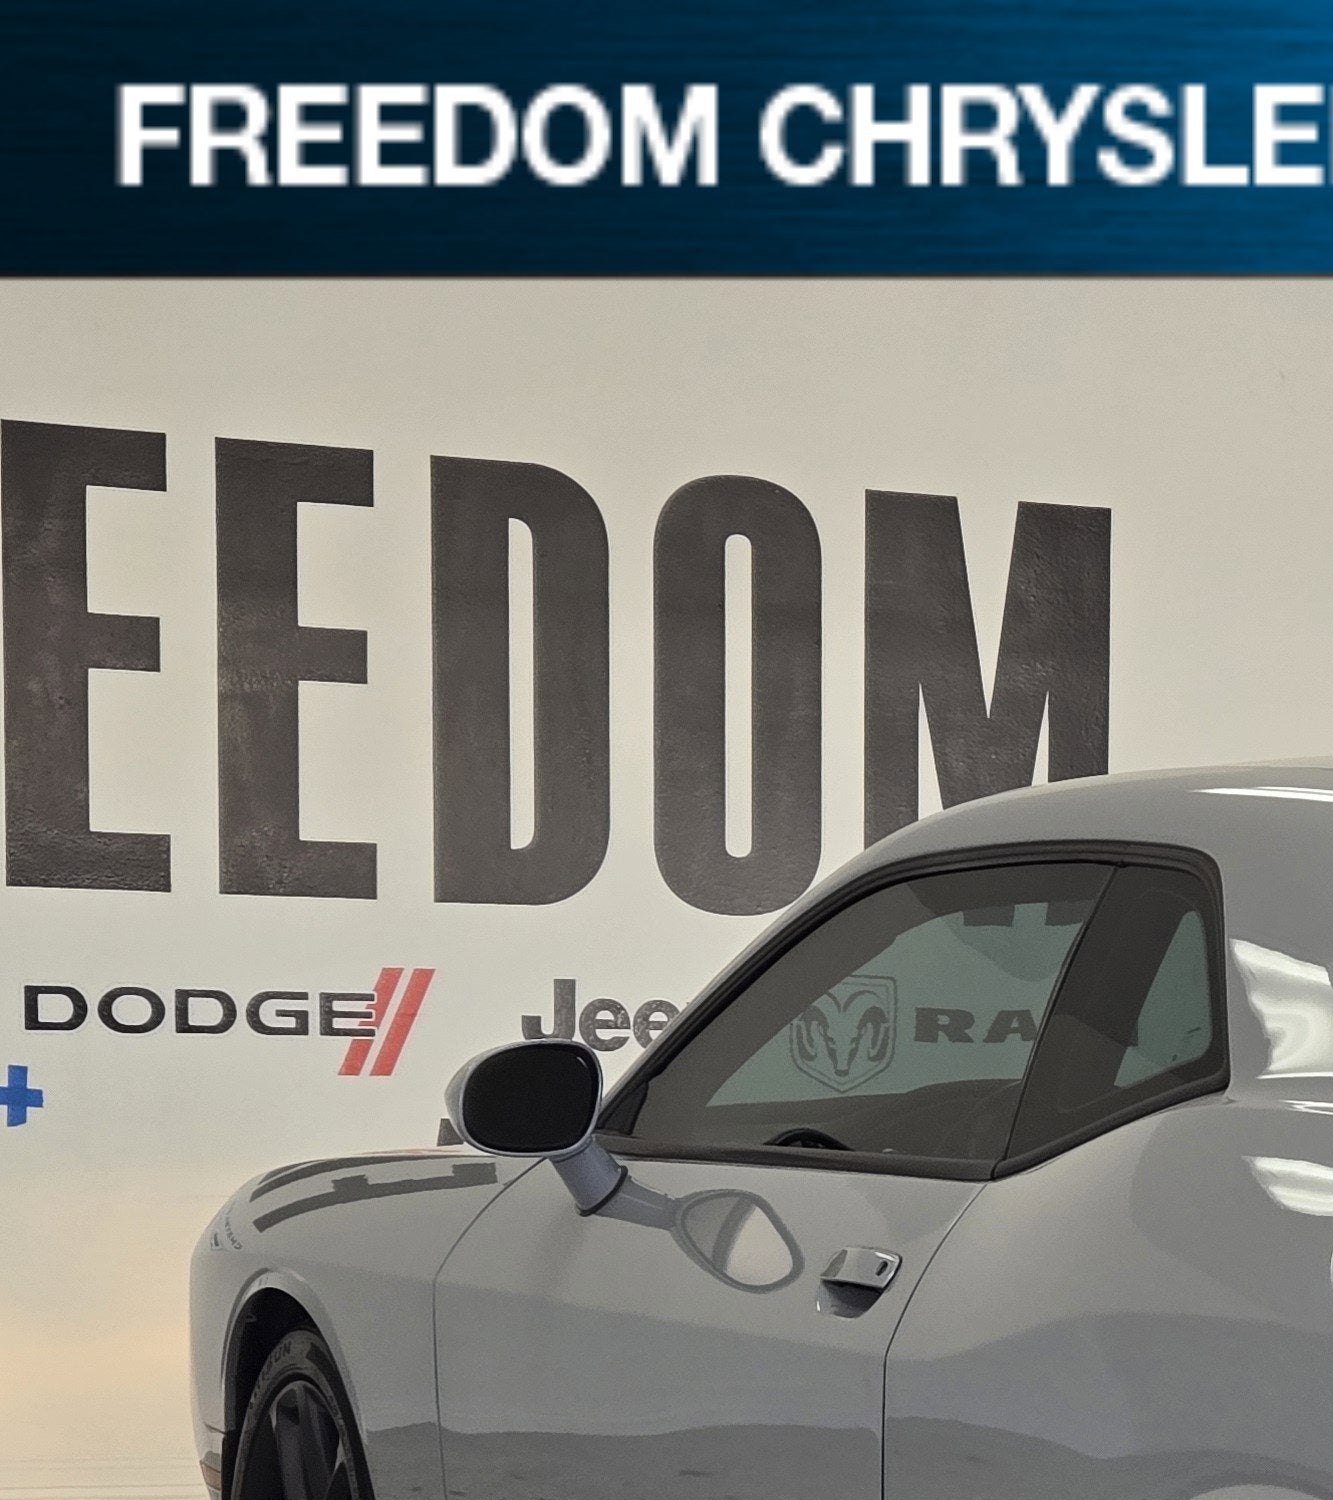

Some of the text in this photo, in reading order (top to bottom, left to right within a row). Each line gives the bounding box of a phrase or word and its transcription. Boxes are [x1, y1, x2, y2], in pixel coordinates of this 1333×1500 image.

[24, 978, 1138, 1051] DODGE Jee RA
